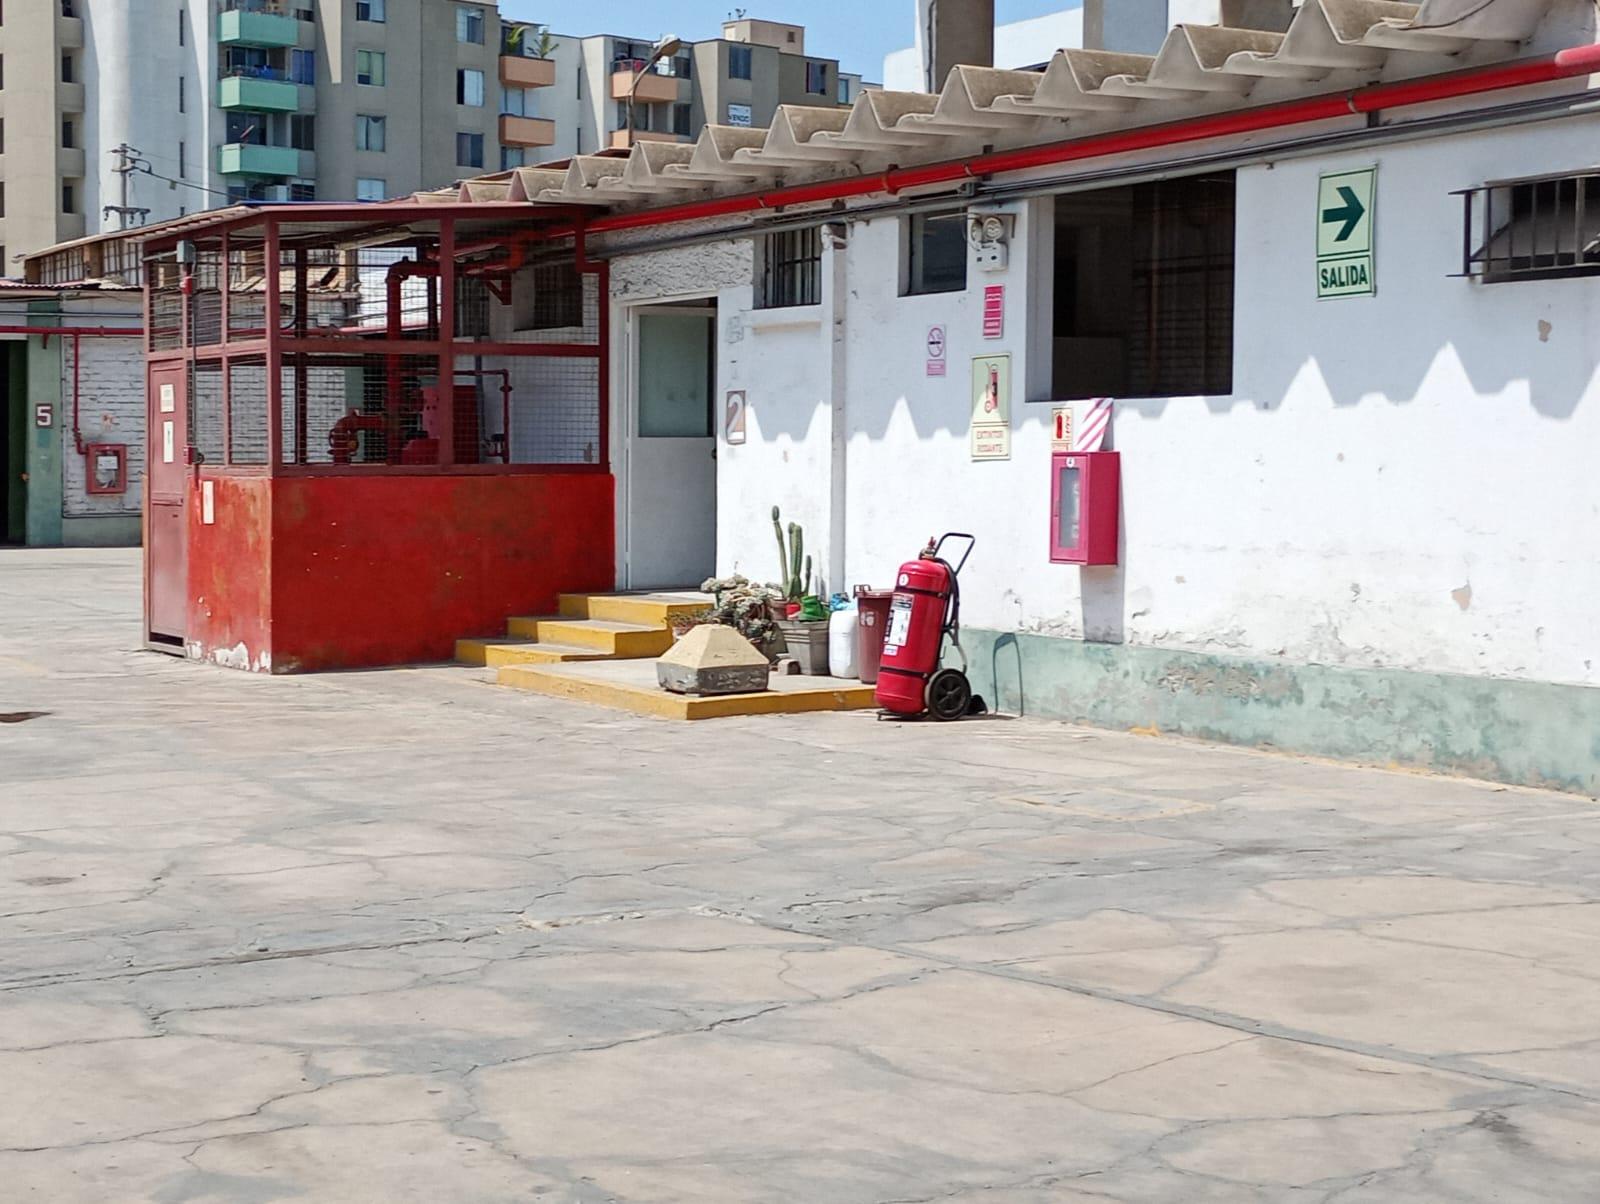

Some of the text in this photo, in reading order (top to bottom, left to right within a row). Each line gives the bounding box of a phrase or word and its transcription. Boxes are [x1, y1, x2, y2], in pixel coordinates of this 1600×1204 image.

[1321, 264, 1368, 288] SALIDA
[37, 406, 51, 426] 5
[727, 393, 744, 440] 2
